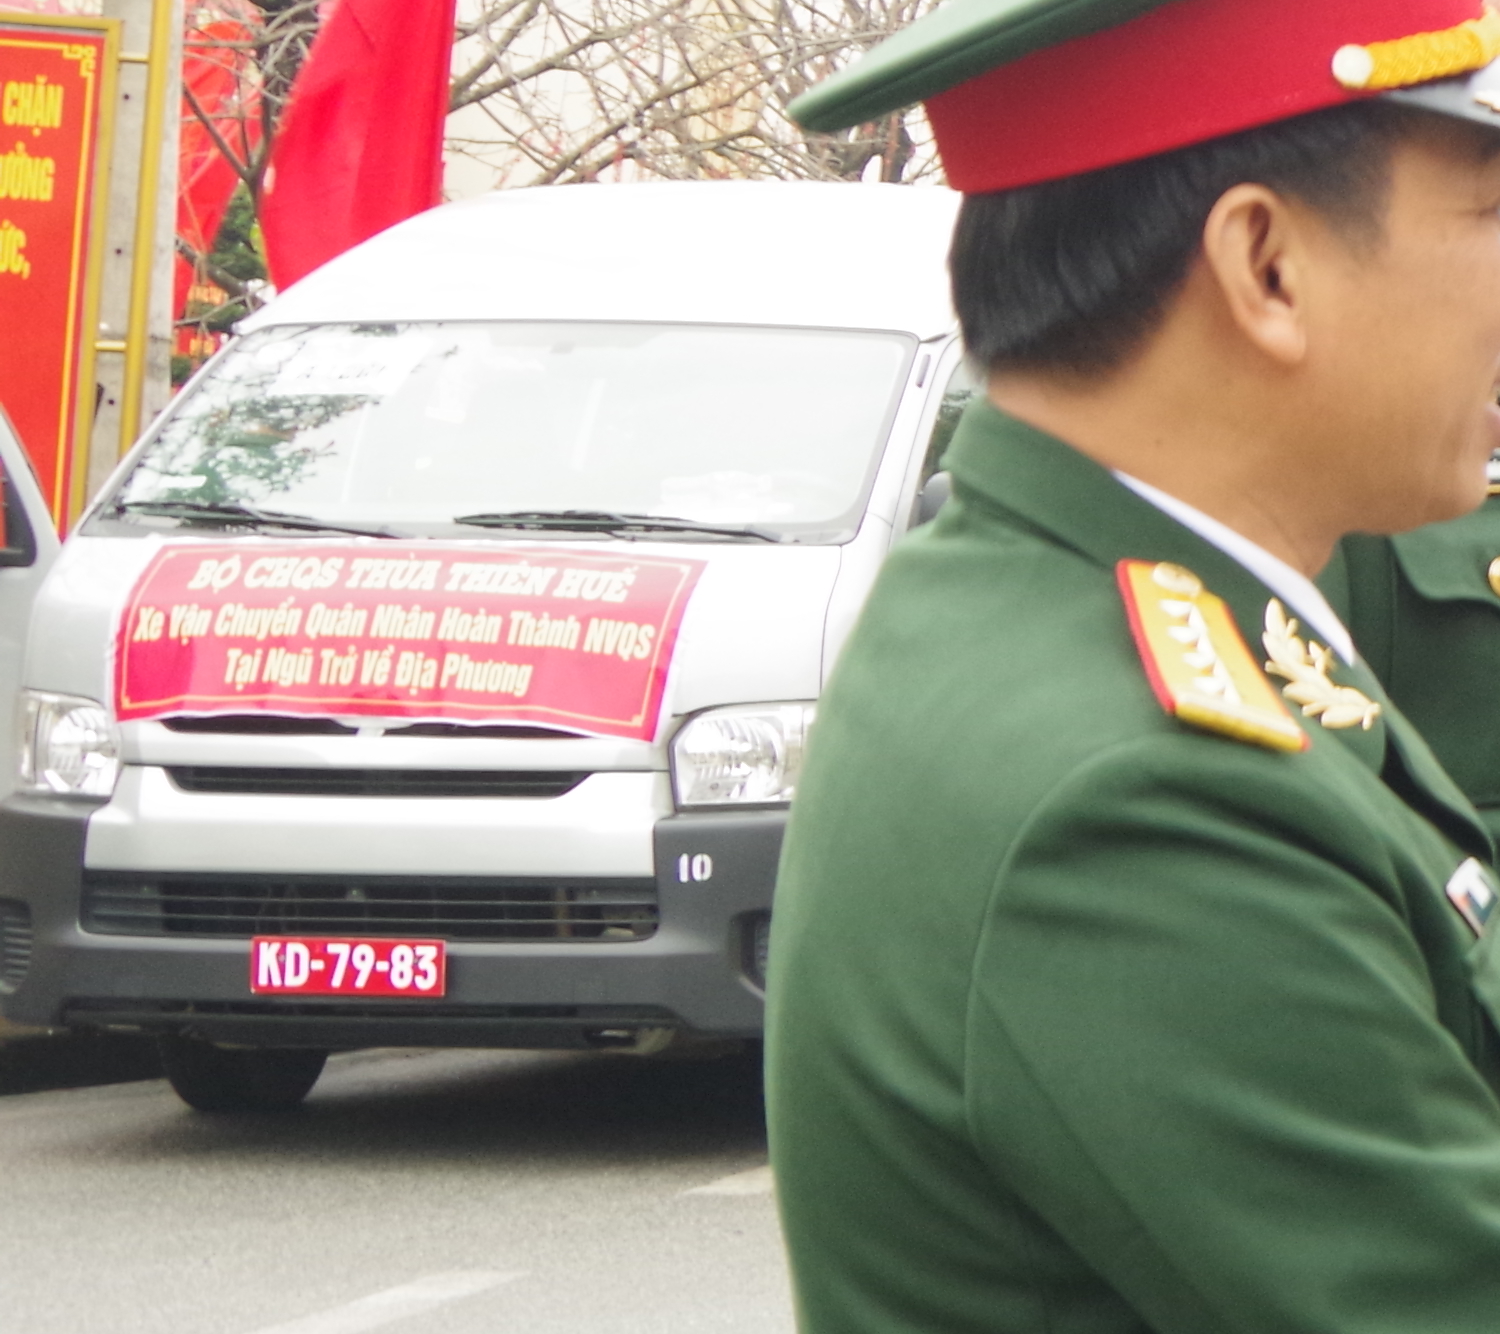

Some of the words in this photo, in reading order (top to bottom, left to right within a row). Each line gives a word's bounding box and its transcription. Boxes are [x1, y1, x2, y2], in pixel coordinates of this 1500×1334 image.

[2, 74, 64, 137] CHẶN
[0, 140, 56, 202] ƯỞNG
[0, 218, 31, 281] ỨC,
[187, 553, 243, 594] BỘ
[244, 556, 345, 592] CHQS
[445, 559, 557, 597] THIÊN
[552, 565, 640, 603] HUẾ
[132, 605, 165, 642] Xe
[169, 603, 213, 646] Vận
[214, 595, 303, 641] Chuyển
[305, 602, 368, 640] Quân
[369, 604, 437, 641] Nhân
[436, 606, 503, 645] Hoàn
[507, 609, 582, 651] Thành
[582, 617, 656, 662] NVQS
[224, 647, 263, 692] Tại
[262, 646, 314, 688] Ngũ
[319, 644, 359, 686] Trở
[394, 650, 438, 696] Địa
[439, 652, 535, 698] Phương
[677, 853, 714, 884] 10
[257, 941, 438, 990] KD-79-83
